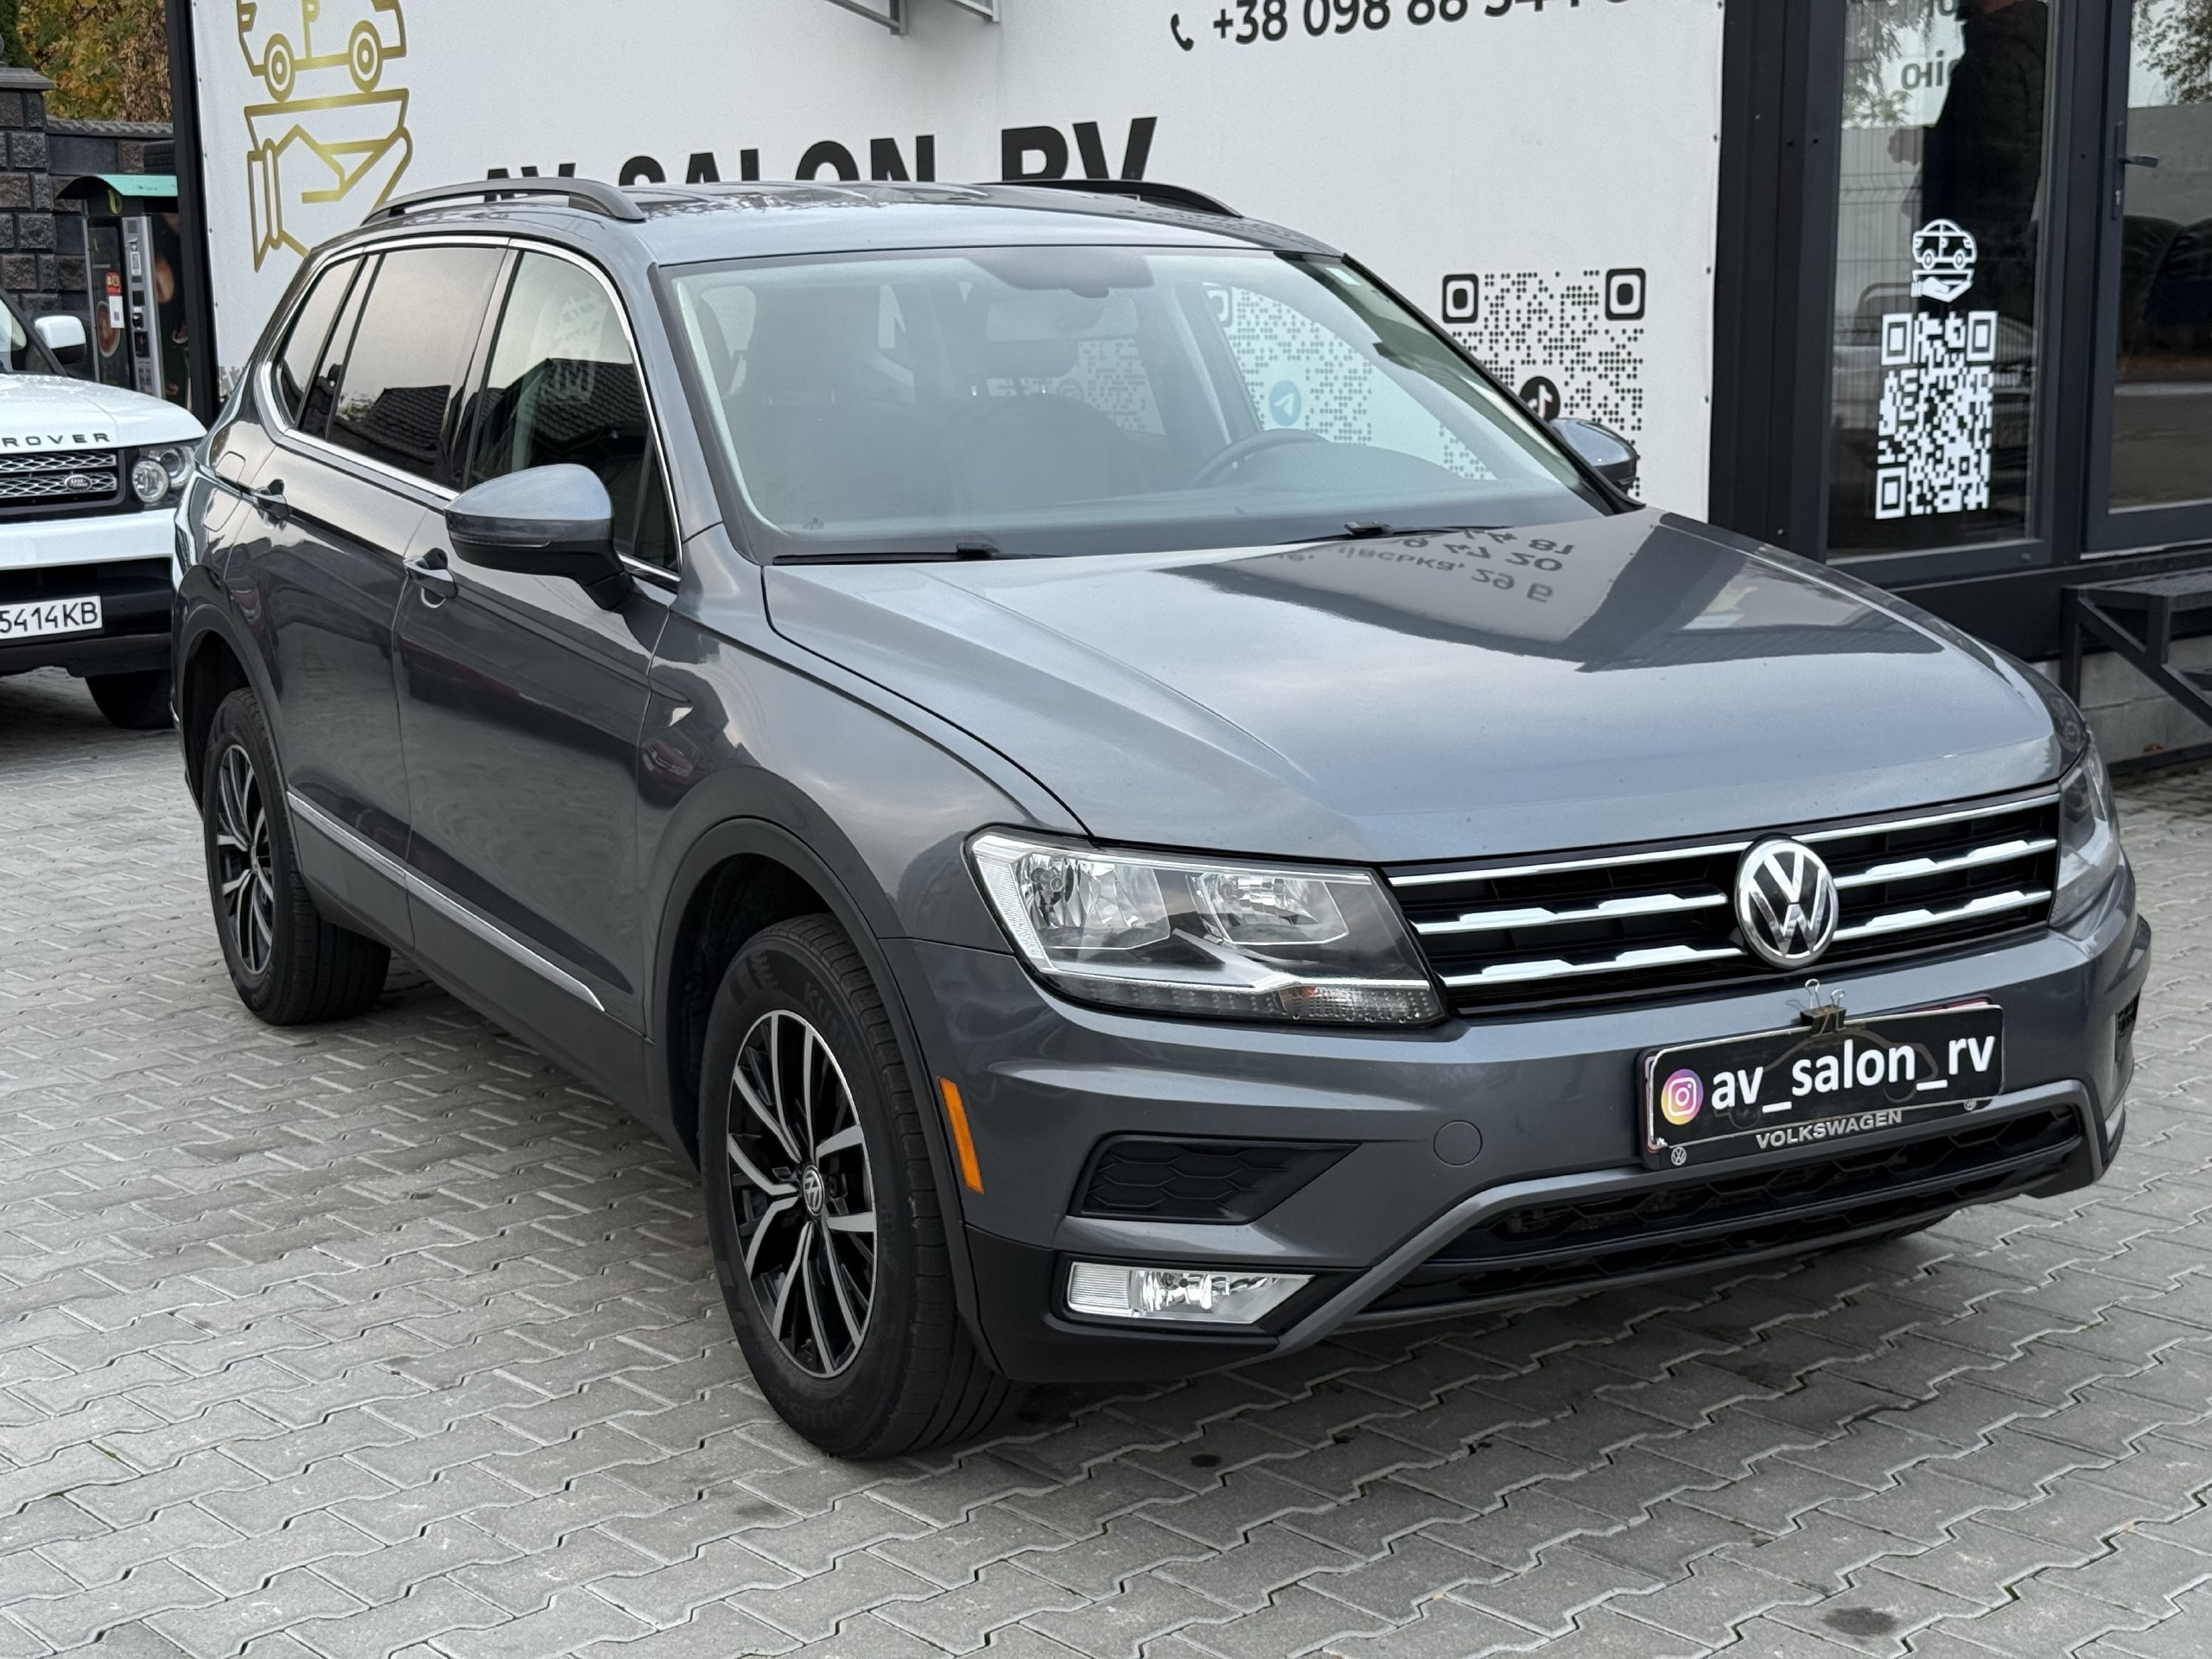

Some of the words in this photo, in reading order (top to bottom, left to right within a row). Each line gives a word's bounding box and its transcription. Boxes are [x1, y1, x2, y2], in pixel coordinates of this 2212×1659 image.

[1213, 0, 1287, 44] +38
[1303, 0, 1390, 36] 098
[2, 431, 111, 447] ROVER
[1711, 1035, 1996, 1114] av_salon_rv
[1756, 1109, 1903, 1150] VOLKSWAGEN
